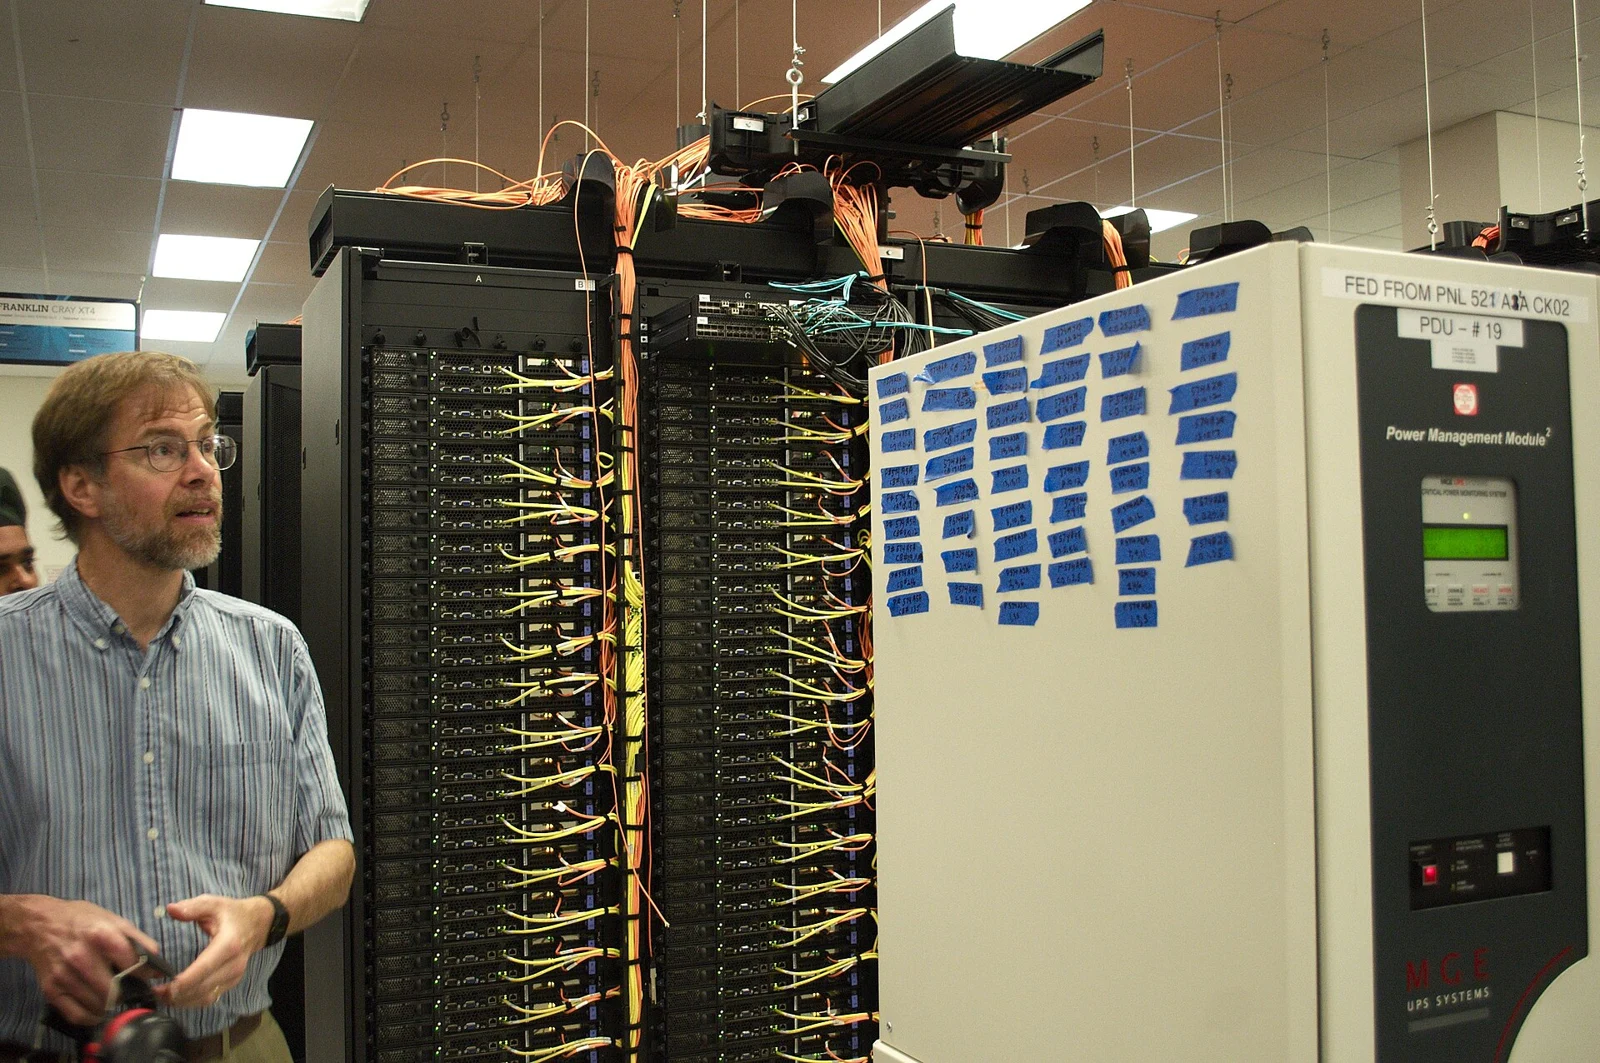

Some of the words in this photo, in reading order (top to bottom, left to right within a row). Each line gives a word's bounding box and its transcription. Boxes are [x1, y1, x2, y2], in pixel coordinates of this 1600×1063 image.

[475, 275, 482, 283] A
[744, 291, 752, 300] C
[1345, 275, 1378, 296] FED
[1384, 280, 1431, 301] FROM
[1436, 285, 1467, 306] PNL
[1471, 290, 1496, 308] 521
[1533, 296, 1570, 317] CK02
[52, 305, 77, 314] CRAY
[78, 306, 96, 315] XT4
[1420, 316, 1454, 336] PDU
[1486, 322, 1503, 340] 19
[1386, 426, 1426, 442] Power
[1428, 428, 1503, 447] Management
[1405, 947, 1490, 992] MGE
[1407, 998, 1430, 1012] UPS
[1436, 986, 1490, 1007] SYSTEMS
